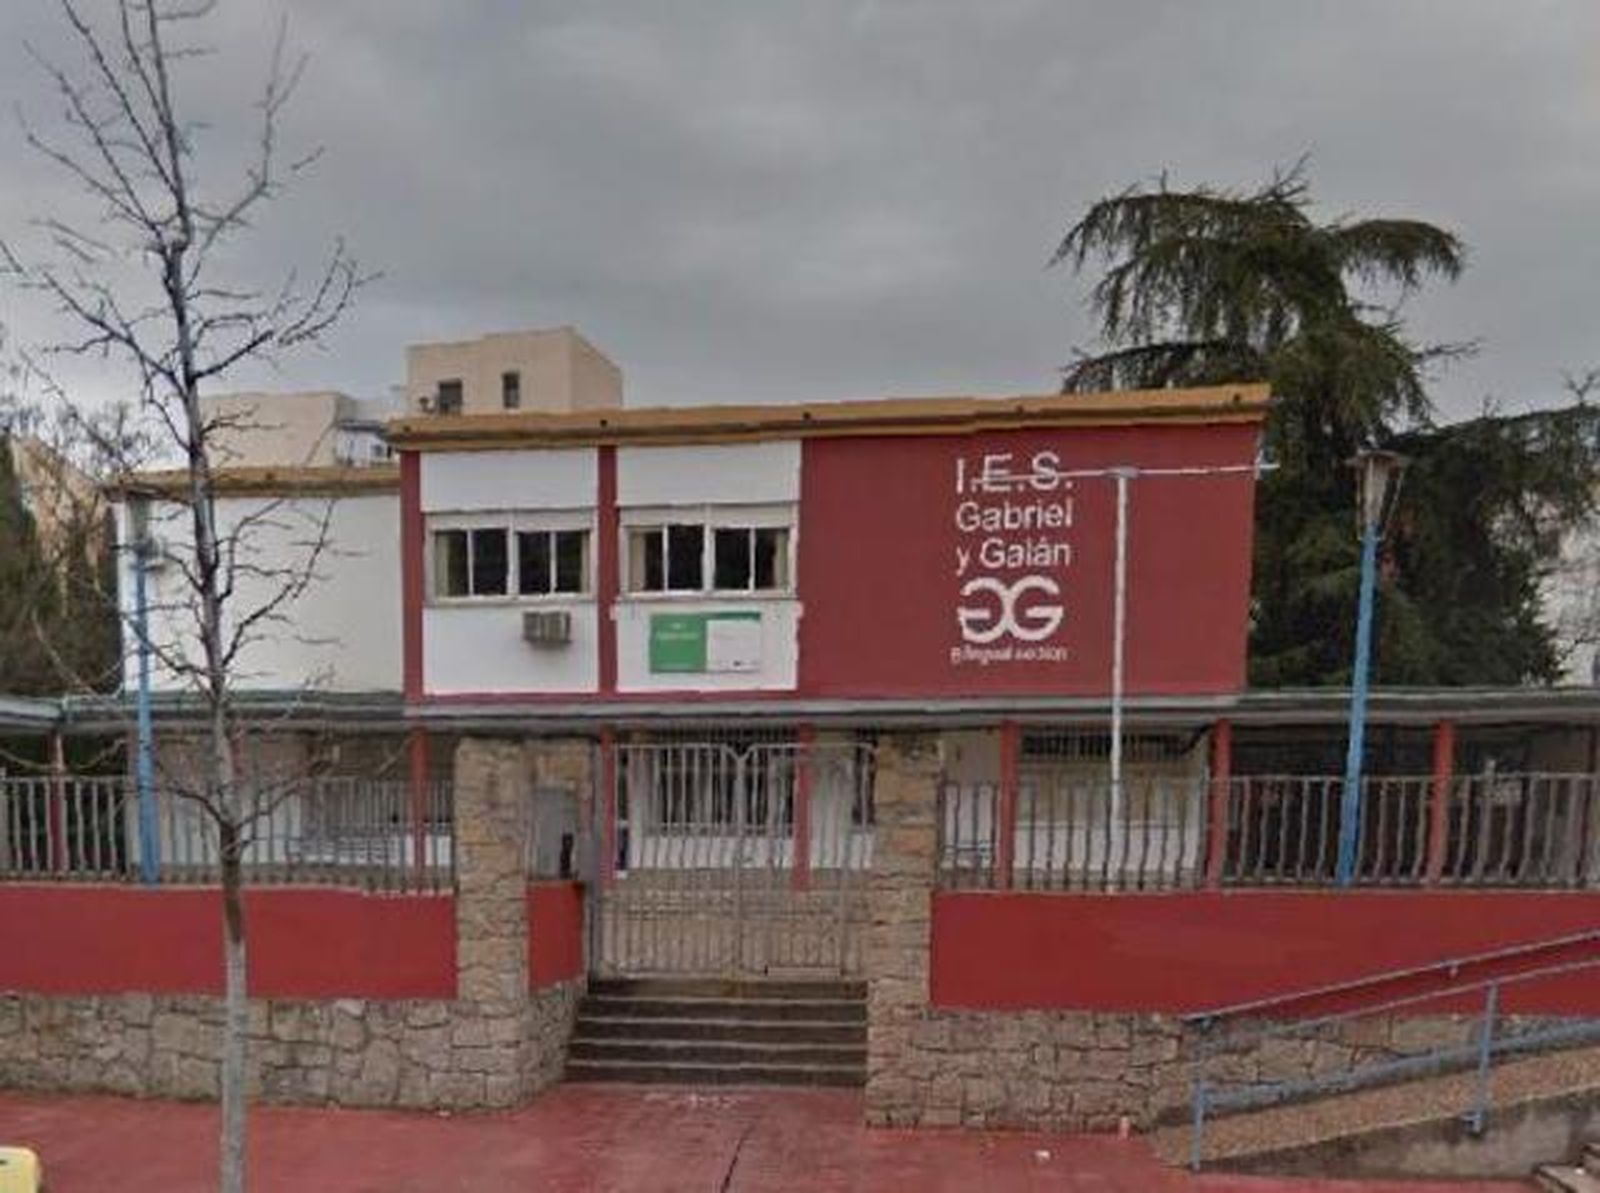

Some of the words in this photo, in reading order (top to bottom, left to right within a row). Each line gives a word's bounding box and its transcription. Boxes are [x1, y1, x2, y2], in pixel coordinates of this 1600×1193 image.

[956, 451, 1073, 494] I.E.S.
[956, 499, 1072, 532] Gabriel
[956, 546, 970, 576] y
[979, 537, 1071, 569] Galán
